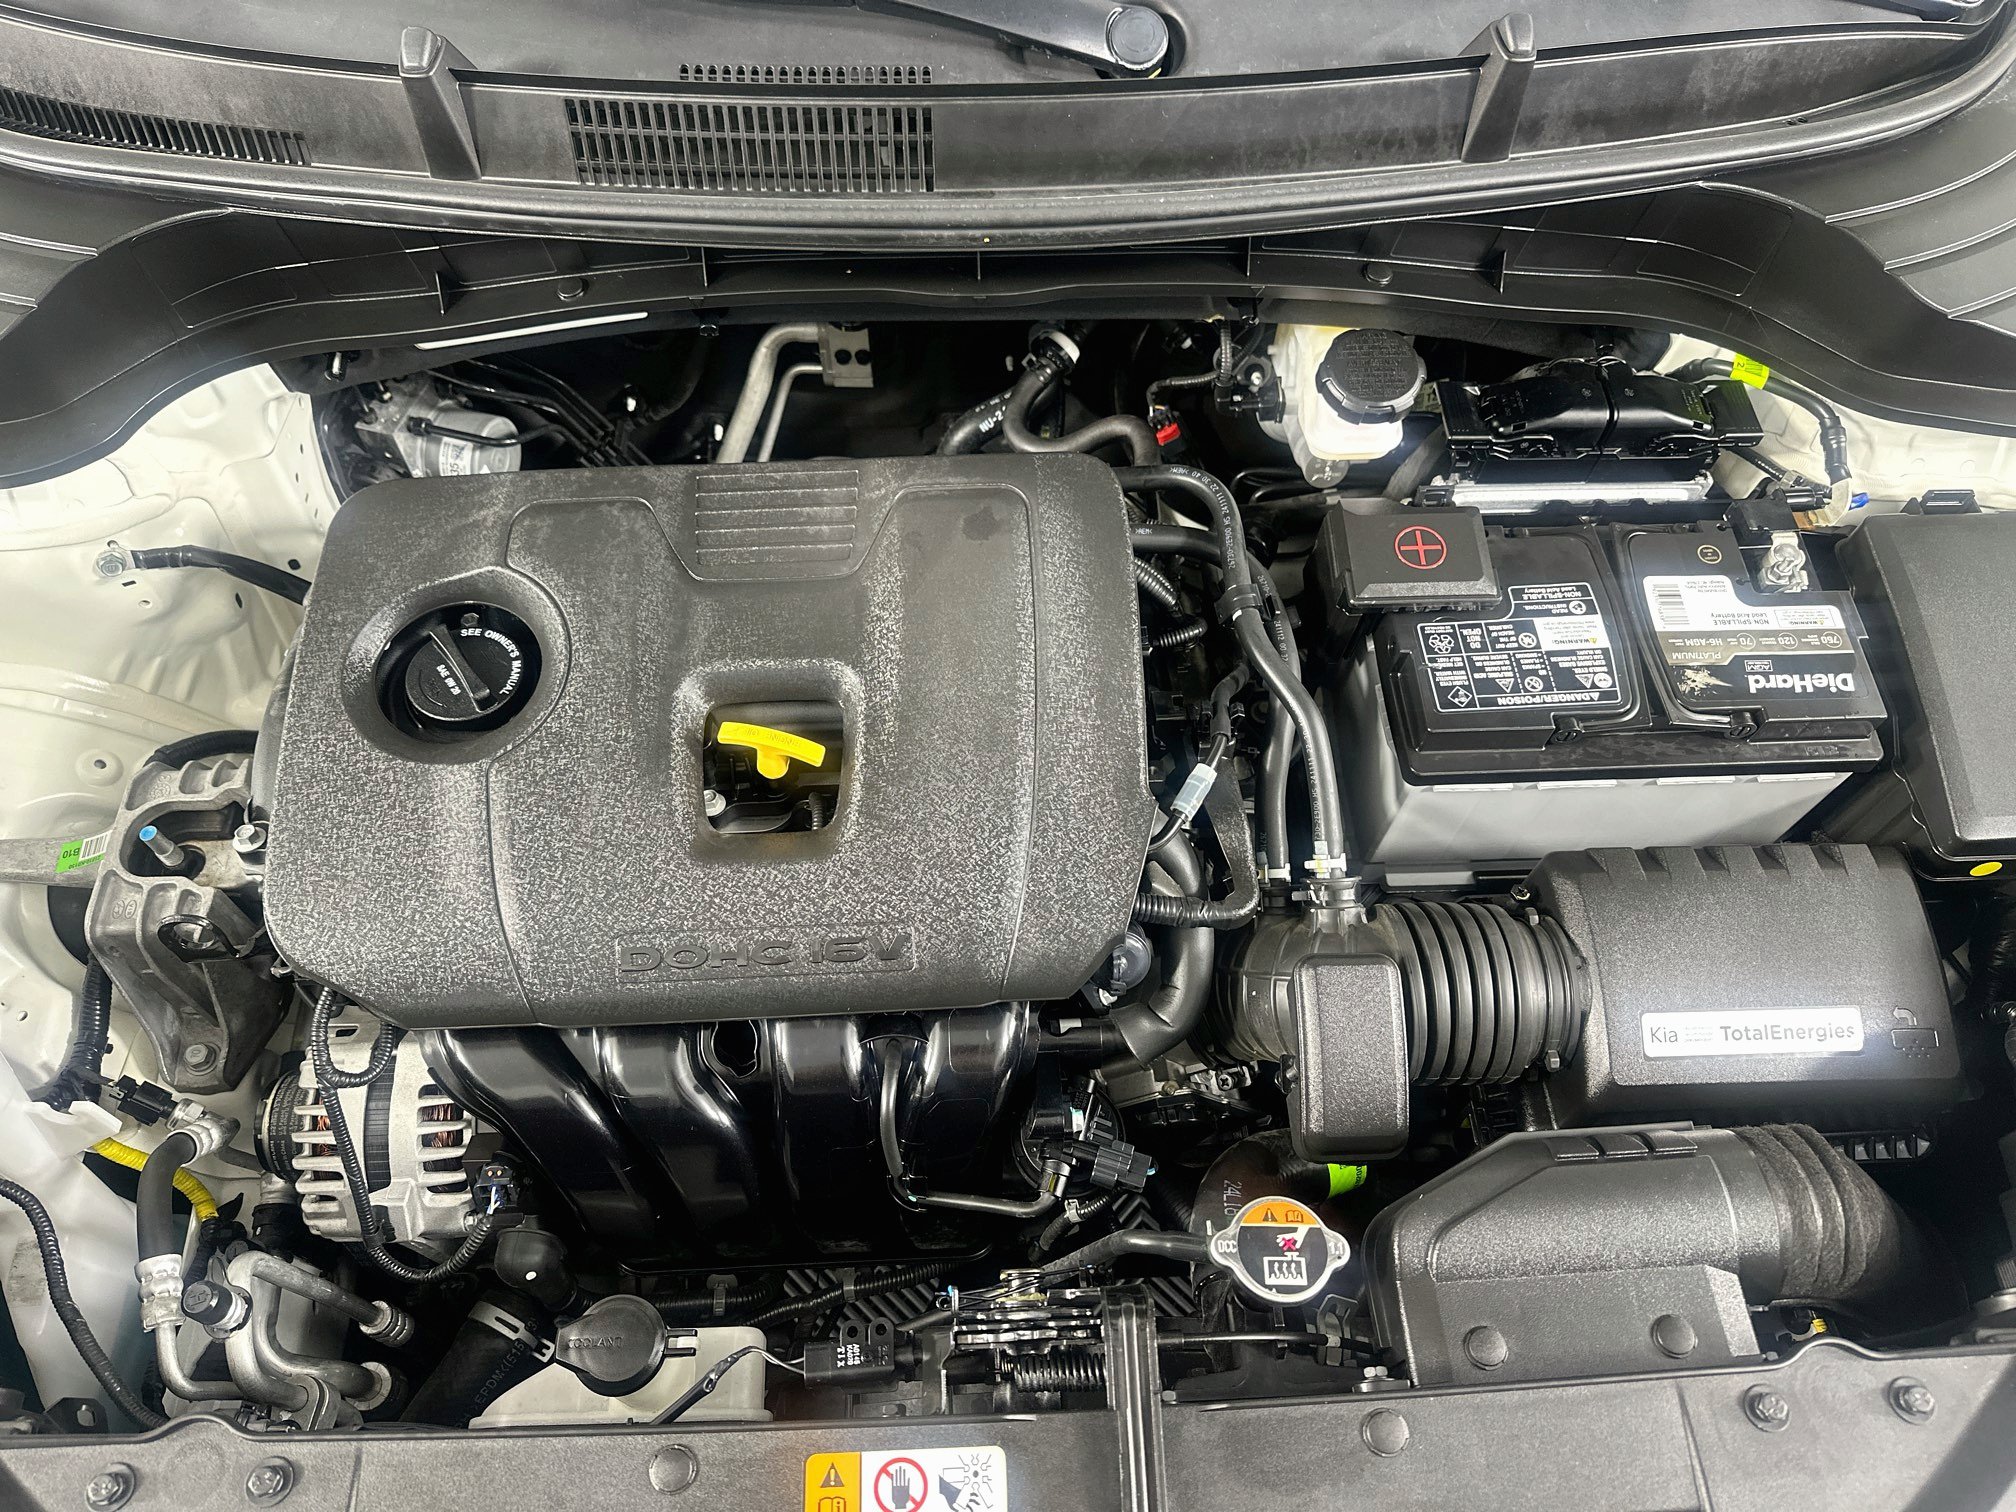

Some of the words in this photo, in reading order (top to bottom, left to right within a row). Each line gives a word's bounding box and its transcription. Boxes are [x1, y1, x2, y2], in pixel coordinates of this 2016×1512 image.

[979, 405, 1006, 433] NU-2
[1522, 591, 1582, 600] NON-SPILLABLE
[460, 628, 482, 637] SEE
[484, 629, 520, 658] OWNER'S
[1684, 637, 1723, 646] H6-AGM
[1739, 637, 1753, 645] 70
[1777, 636, 1795, 645] 120
[1820, 635, 1840, 644] 760
[1672, 651, 1722, 660] PLATINUM
[436, 664, 450, 679] SAE
[499, 659, 522, 696] MANUAL
[1497, 692, 1591, 705] DANGER/POISON
[62, 847, 80, 859] B10
[620, 940, 793, 973] DOHC
[809, 933, 911, 965] 16V
[1650, 1026, 1679, 1044] Kia
[1719, 1023, 1856, 1043] TotalEnergies
[1328, 1241, 1344, 1255] 1.1
[568, 1335, 624, 1348] COOLANT
